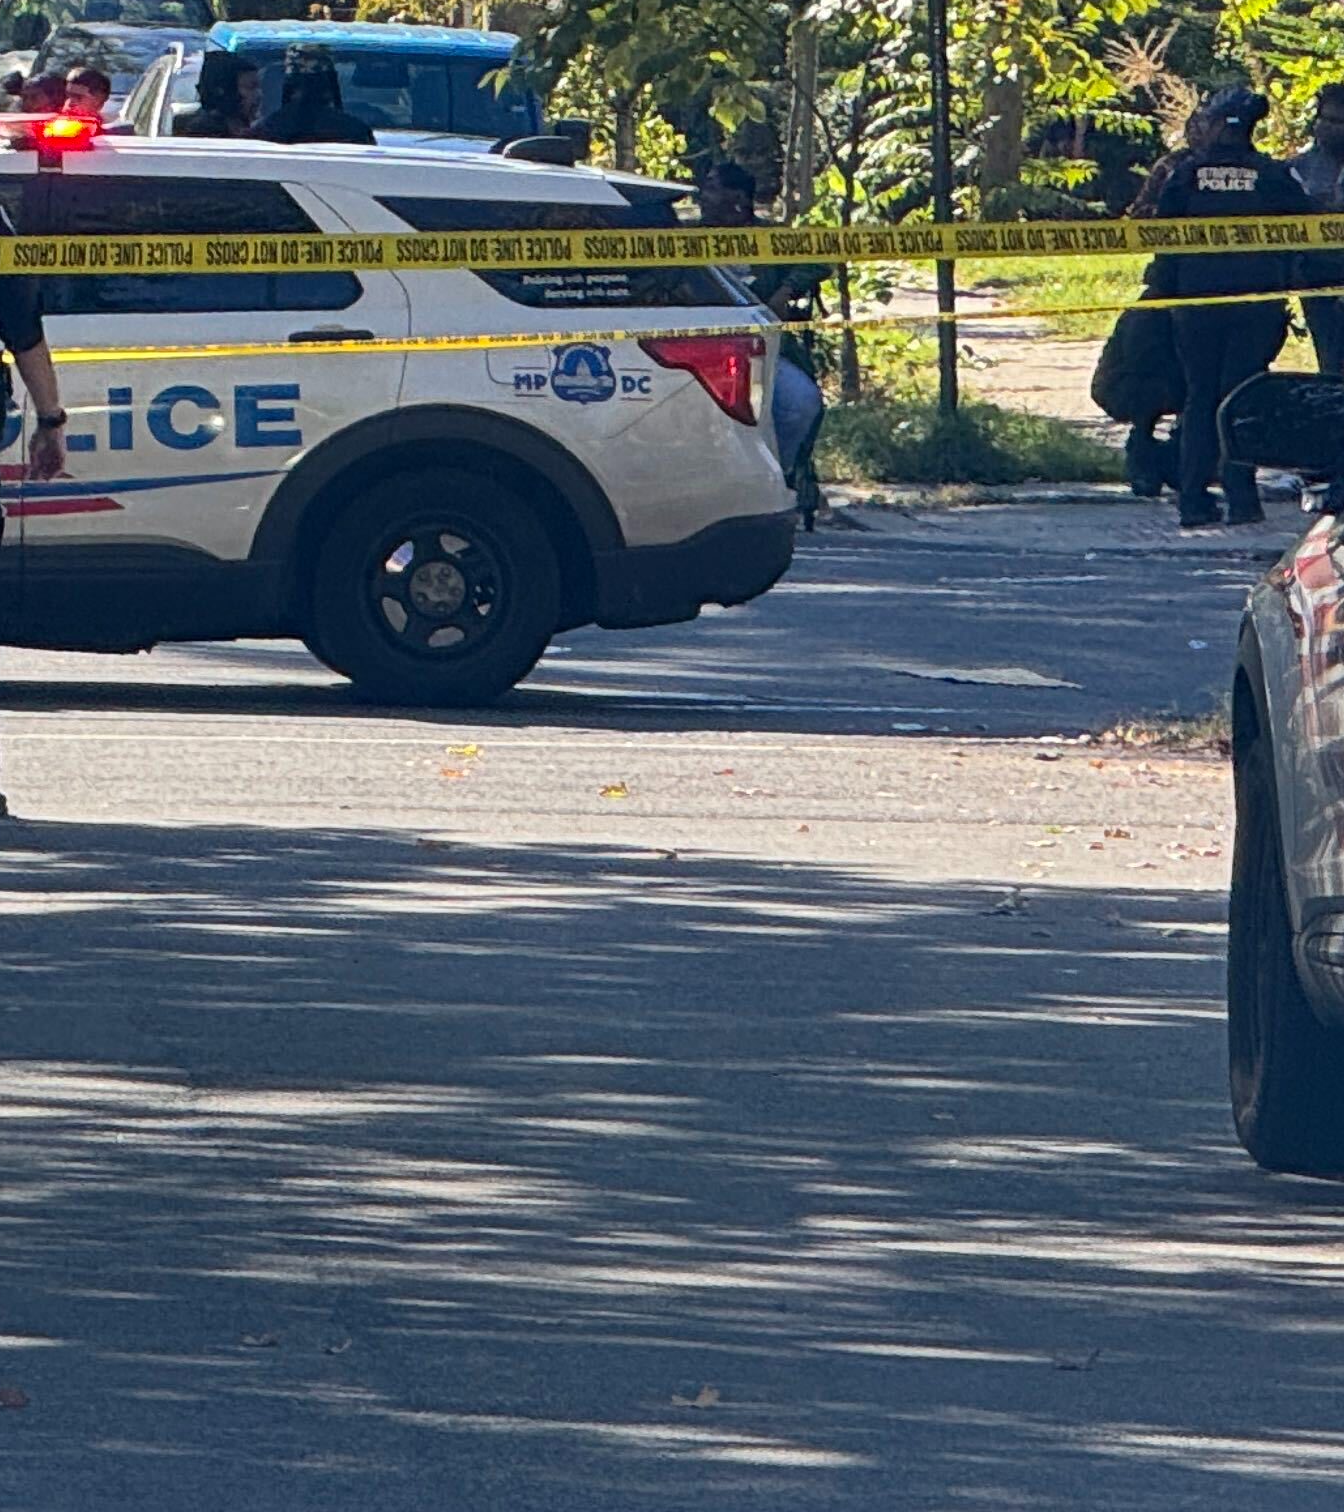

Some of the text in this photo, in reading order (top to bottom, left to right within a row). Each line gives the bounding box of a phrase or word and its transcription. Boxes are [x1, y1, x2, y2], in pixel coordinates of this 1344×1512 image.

[657, 236, 675, 258] DO
[713, 233, 759, 257] POLICE
[770, 232, 813, 256] CROSS
[814, 232, 841, 256] NOT
[843, 232, 861, 255] DO
[897, 230, 944, 253] POLICE
[1027, 228, 1045, 251] DO
[1209, 224, 1229, 247] DO
[13, 243, 56, 267] CROSS
[60, 243, 87, 267] NOT
[89, 243, 106, 266] DO
[146, 242, 193, 266] POLICE
[206, 241, 249, 265] CROSS
[251, 241, 278, 265] NOT
[281, 240, 299, 265] DO
[337, 239, 383, 264] POLICE
[396, 239, 440, 262] CROSS
[441, 238, 467, 262] NOT
[470, 238, 488, 262] DO
[525, 236, 571, 261] POLICE
[583, 236, 627, 260] CROSS
[629, 236, 655, 260] NOT
[514, 373, 652, 394] MP DC
